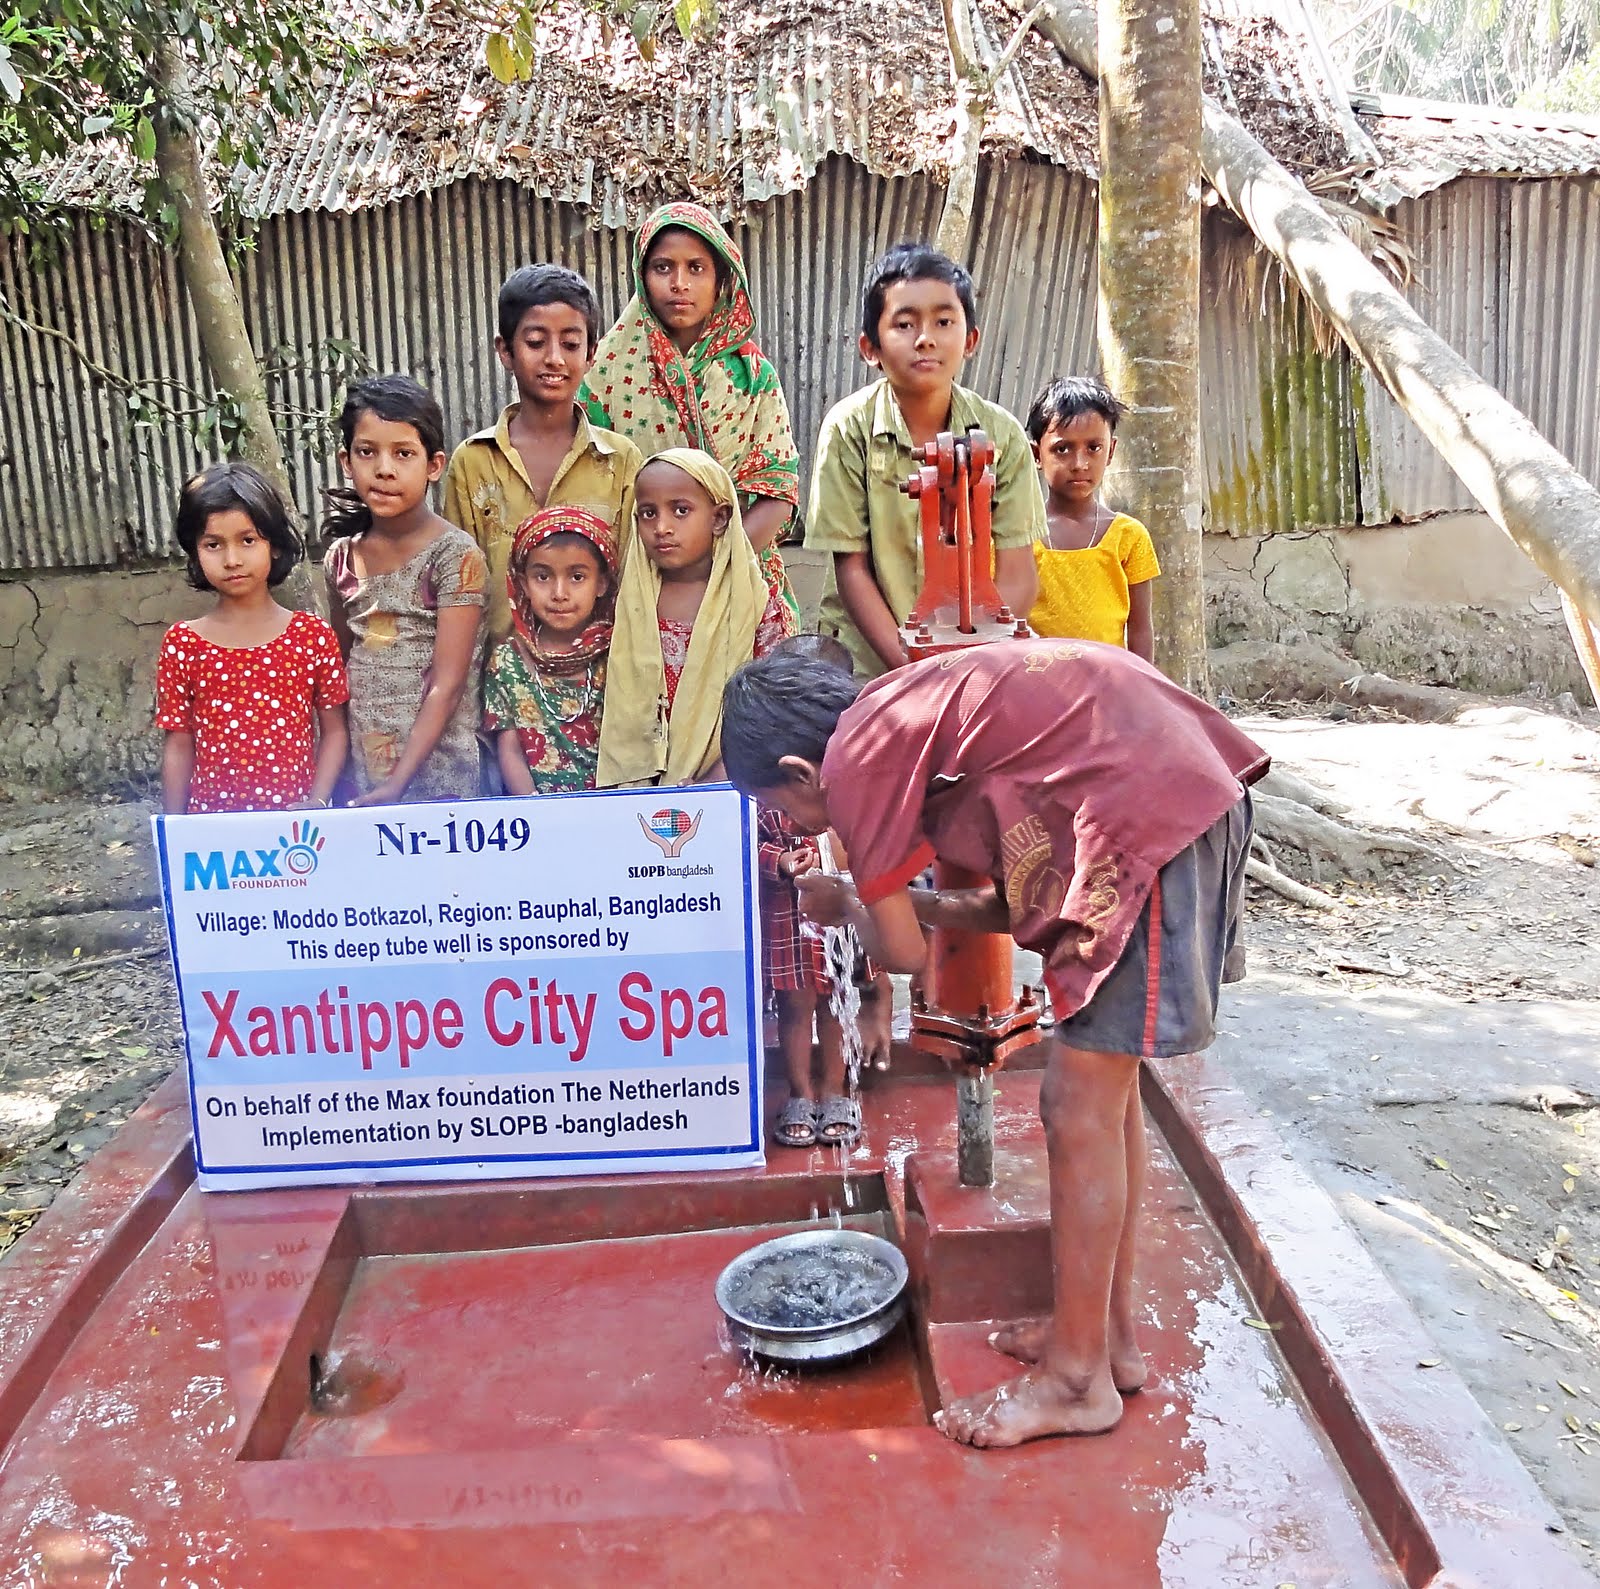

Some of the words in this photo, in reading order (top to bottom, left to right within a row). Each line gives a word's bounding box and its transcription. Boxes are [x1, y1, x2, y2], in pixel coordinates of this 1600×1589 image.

[374, 816, 531, 857] Nr-1049
[651, 818, 671, 827] SLOPB
[184, 849, 283, 891] MAX
[232, 878, 307, 889] FOUNDATION
[628, 865, 665, 878] SLOPB
[666, 864, 714, 879] bangladesh
[196, 911, 267, 936] Village:
[273, 908, 338, 930] Moddo
[344, 904, 433, 927] Botkazol,
[439, 902, 512, 927] Region:
[519, 897, 602, 923] Bauphal,
[609, 892, 721, 919] Bangladesh
[287, 939, 328, 960] This
[334, 939, 380, 961] deep
[386, 936, 428, 956] tube
[434, 934, 471, 954] well
[477, 933, 493, 952] is
[499, 928, 600, 955] sponsored
[607, 927, 629, 951] by
[201, 985, 464, 1070] Xantippe
[484, 977, 597, 1062] City
[618, 971, 729, 1057] Spa
[206, 1096, 237, 1118] On
[243, 1093, 312, 1116] behalf
[318, 1092, 340, 1113] of
[345, 1092, 380, 1111] the
[386, 1089, 430, 1110] Max
[436, 1084, 555, 1108] foundation
[561, 1082, 602, 1102] The
[609, 1076, 740, 1101] Netherlands
[262, 1122, 430, 1150] Implementation
[437, 1119, 463, 1144] by
[470, 1115, 548, 1137] SLOPB
